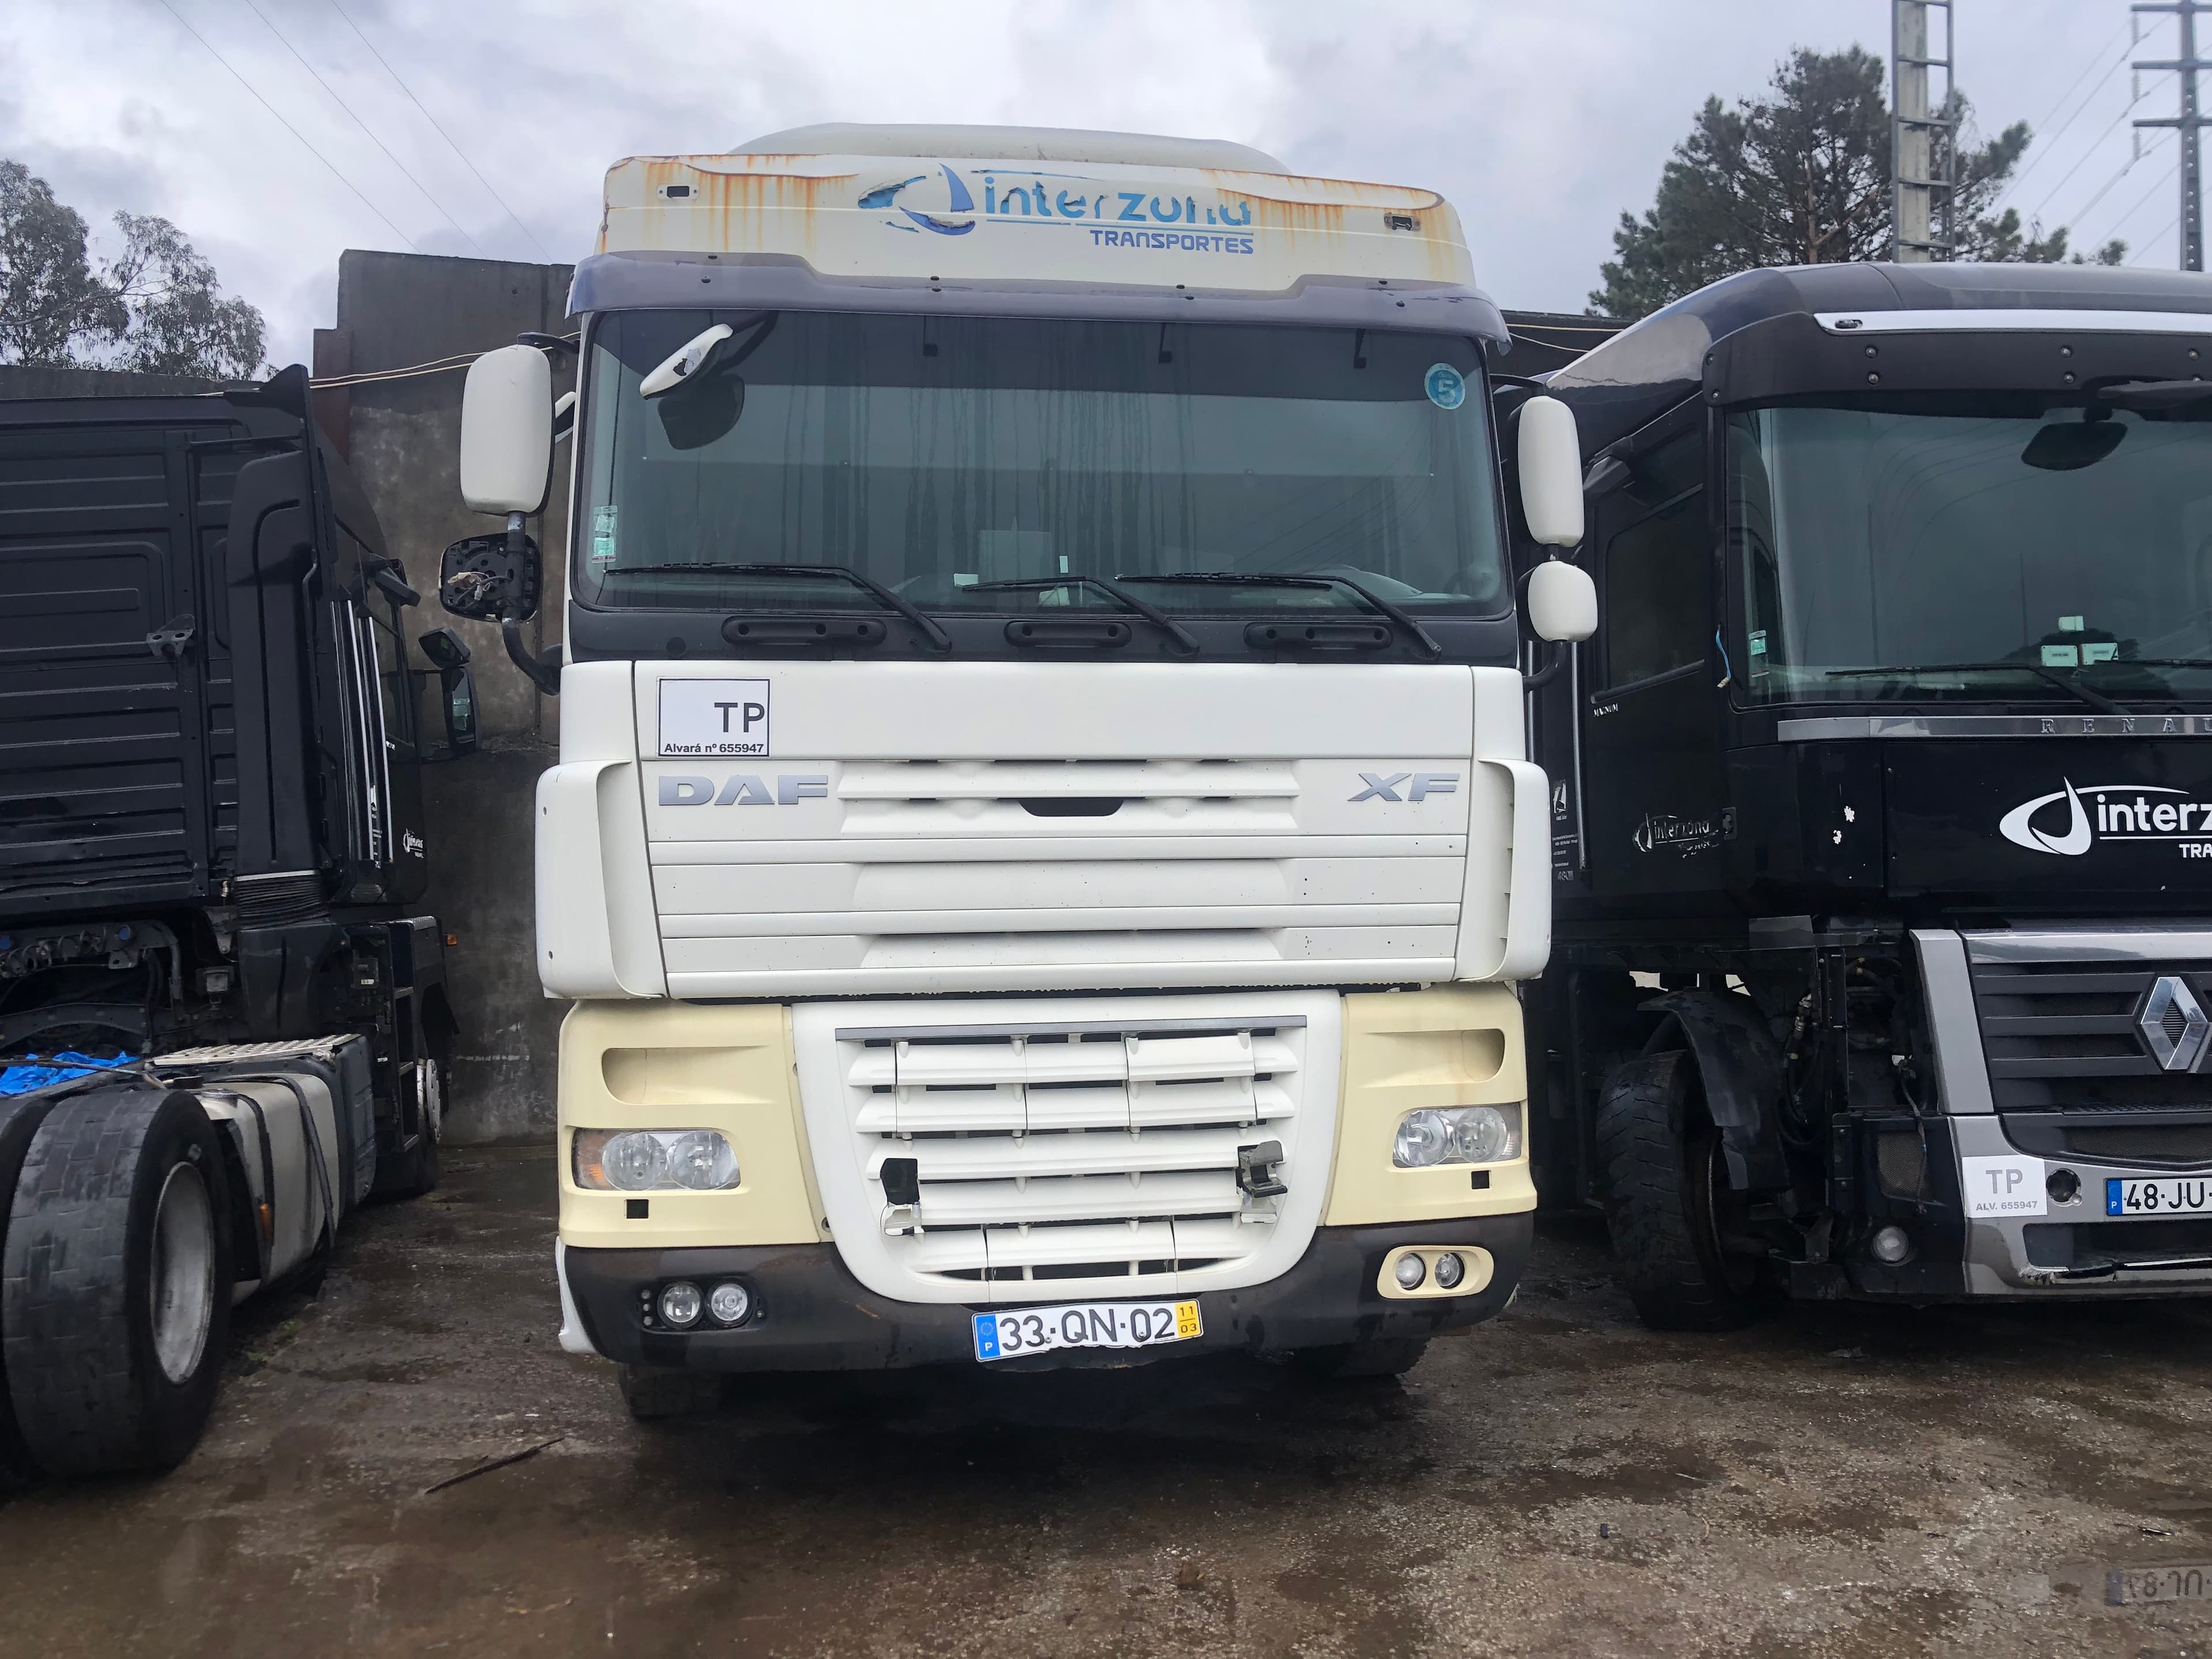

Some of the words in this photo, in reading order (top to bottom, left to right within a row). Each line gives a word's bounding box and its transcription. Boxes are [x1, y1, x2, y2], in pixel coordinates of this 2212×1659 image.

[1090, 230, 1253, 254] TRANSPORTES
[714, 702, 766, 733] TP
[664, 743, 701, 753] Alvará
[705, 744, 717, 753] nº
[719, 743, 764, 753] 655947
[659, 775, 828, 806] DAF
[1347, 772, 1461, 801] XF
[1986, 1169, 2023, 1194] TP
[1976, 1203, 1998, 1211] ALV.
[2001, 1200, 2037, 1210] 655947
[2111, 1201, 2117, 1210] P
[1180, 1306, 1193, 1317] 11
[1181, 1323, 1197, 1333] 03
[984, 1342, 993, 1352] P
